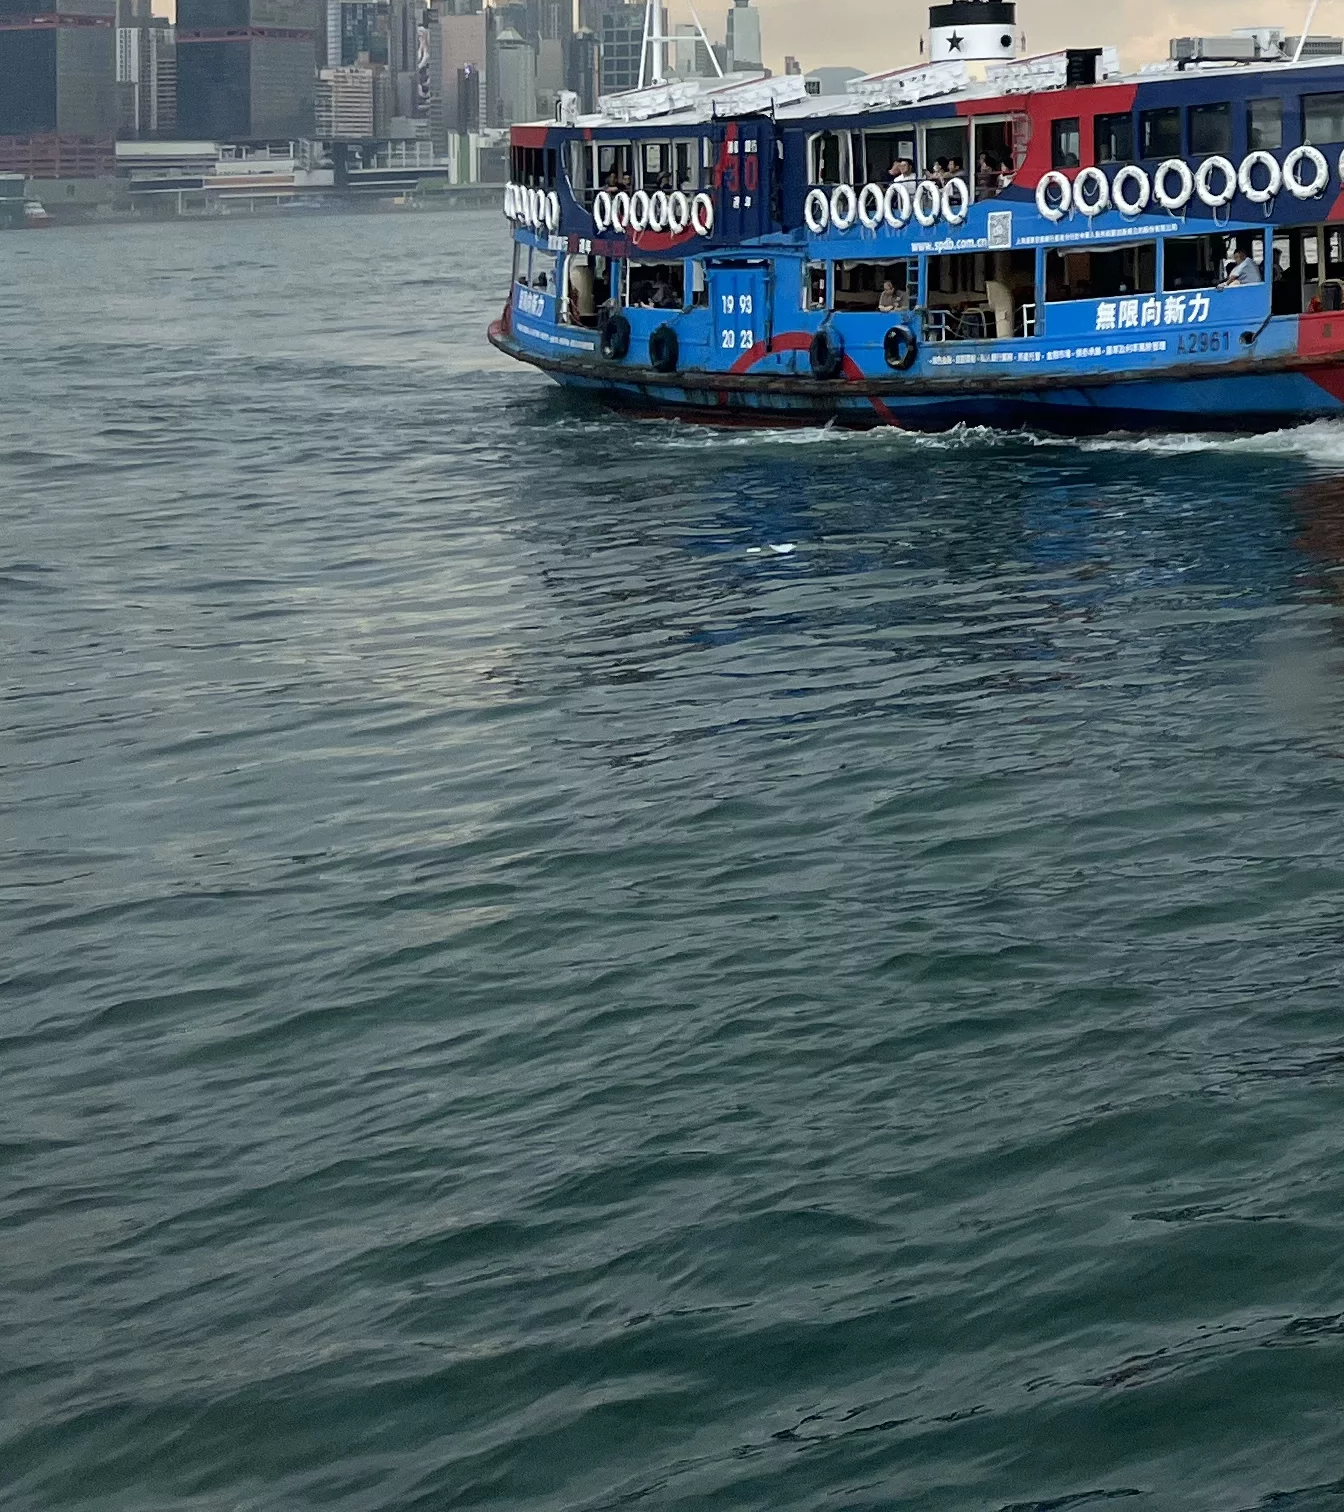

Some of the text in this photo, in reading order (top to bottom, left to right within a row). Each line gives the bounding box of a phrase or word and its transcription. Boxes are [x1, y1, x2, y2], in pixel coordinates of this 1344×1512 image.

[1095, 293, 1210, 330] 無限向新力
